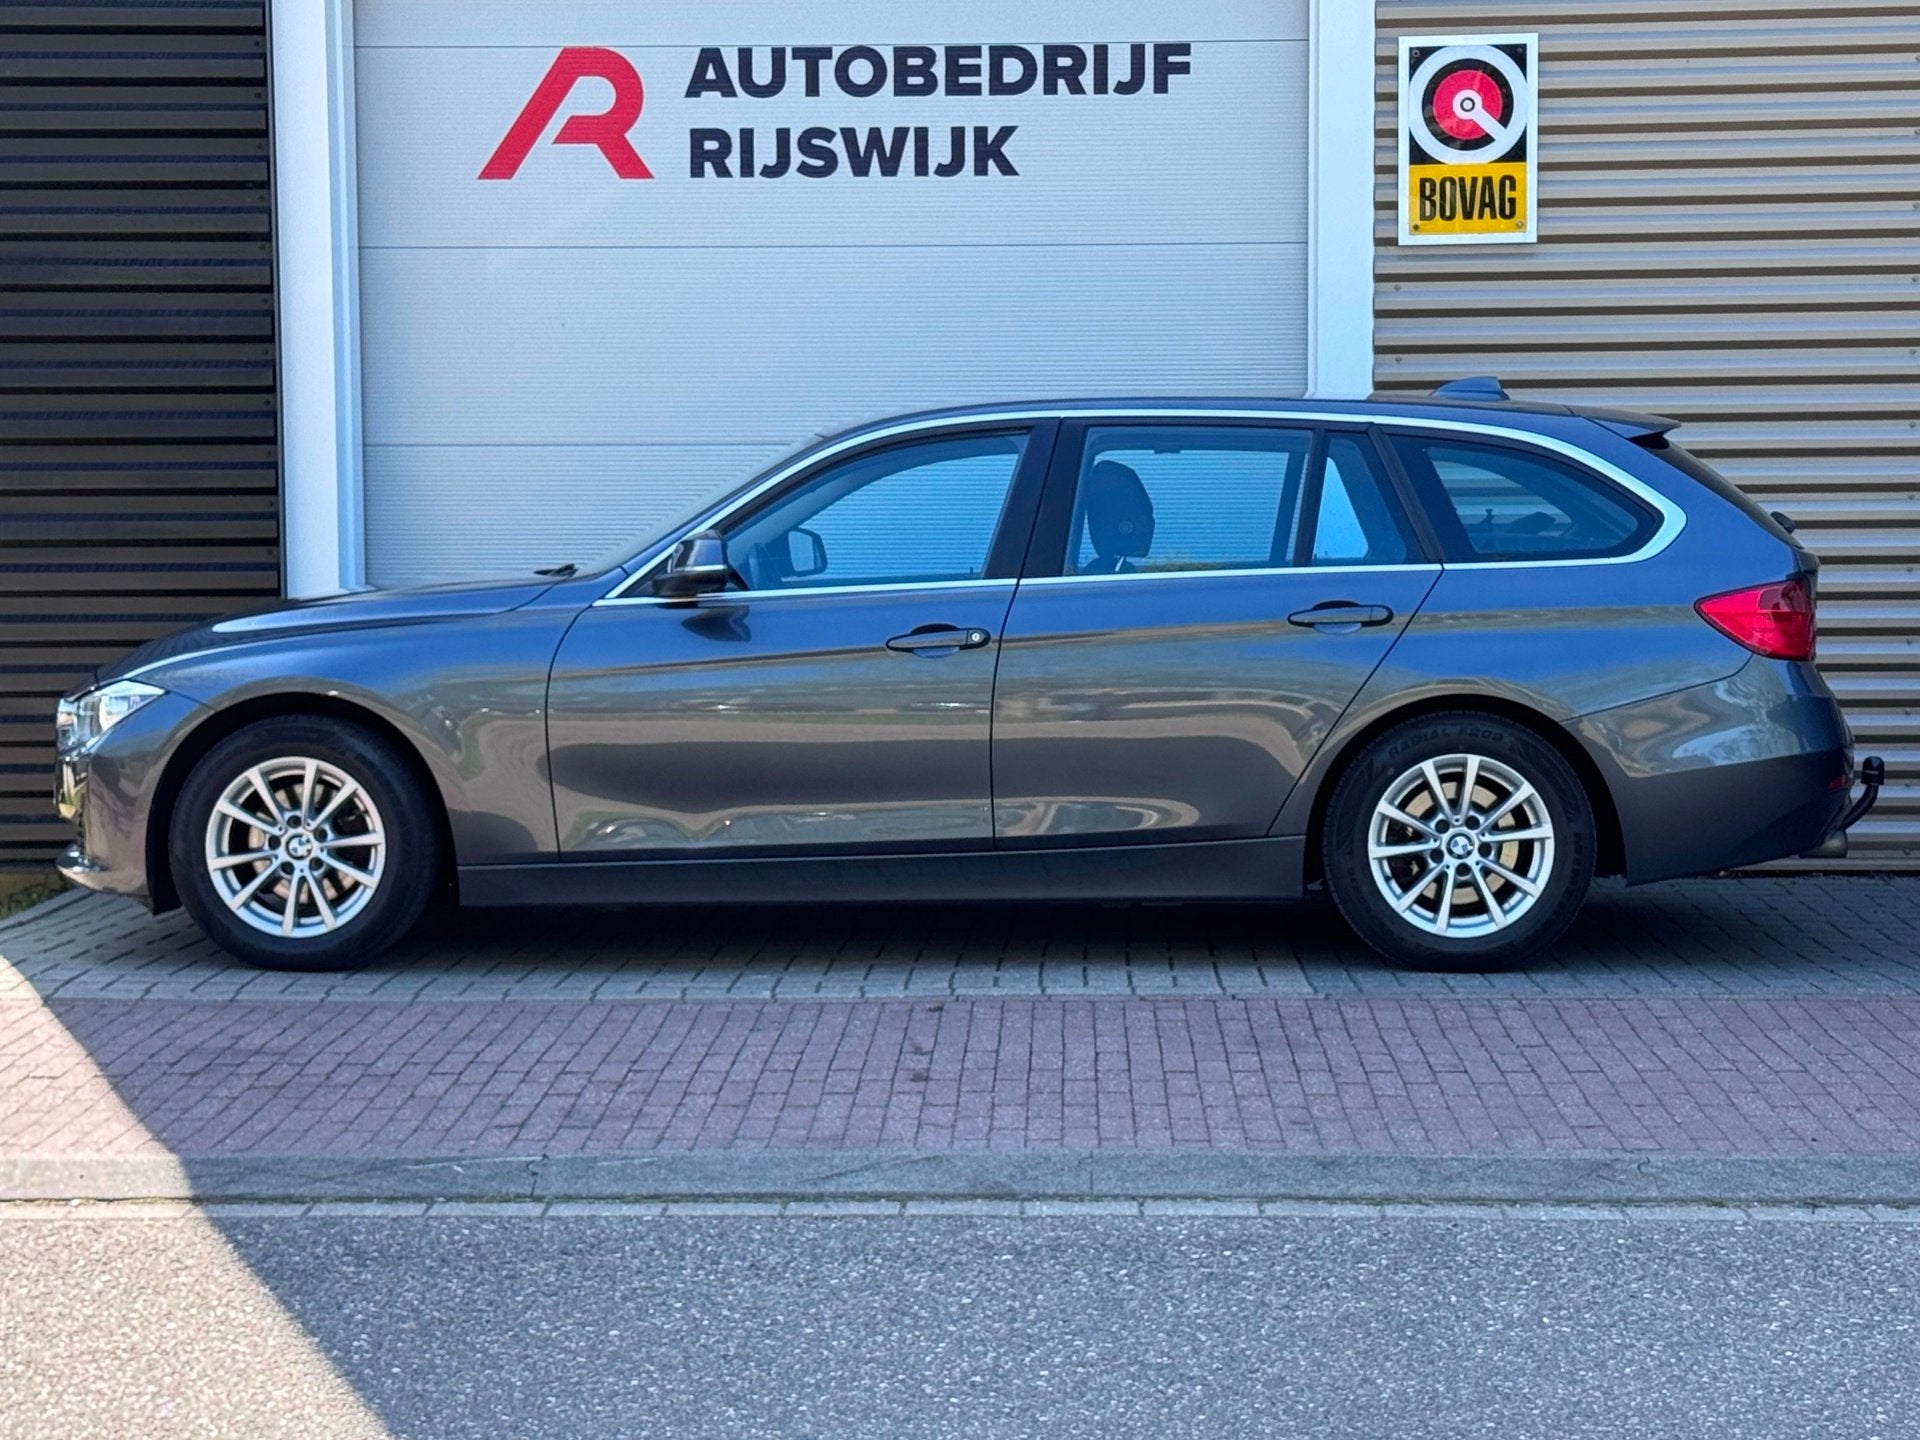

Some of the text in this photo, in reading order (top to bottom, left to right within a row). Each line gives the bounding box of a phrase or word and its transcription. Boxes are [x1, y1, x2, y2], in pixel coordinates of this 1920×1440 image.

[684, 43, 1191, 98] AUTOBEDRIJF
[689, 126, 1020, 179] RIJSWIJK
[1419, 174, 1517, 222] BOVAG
